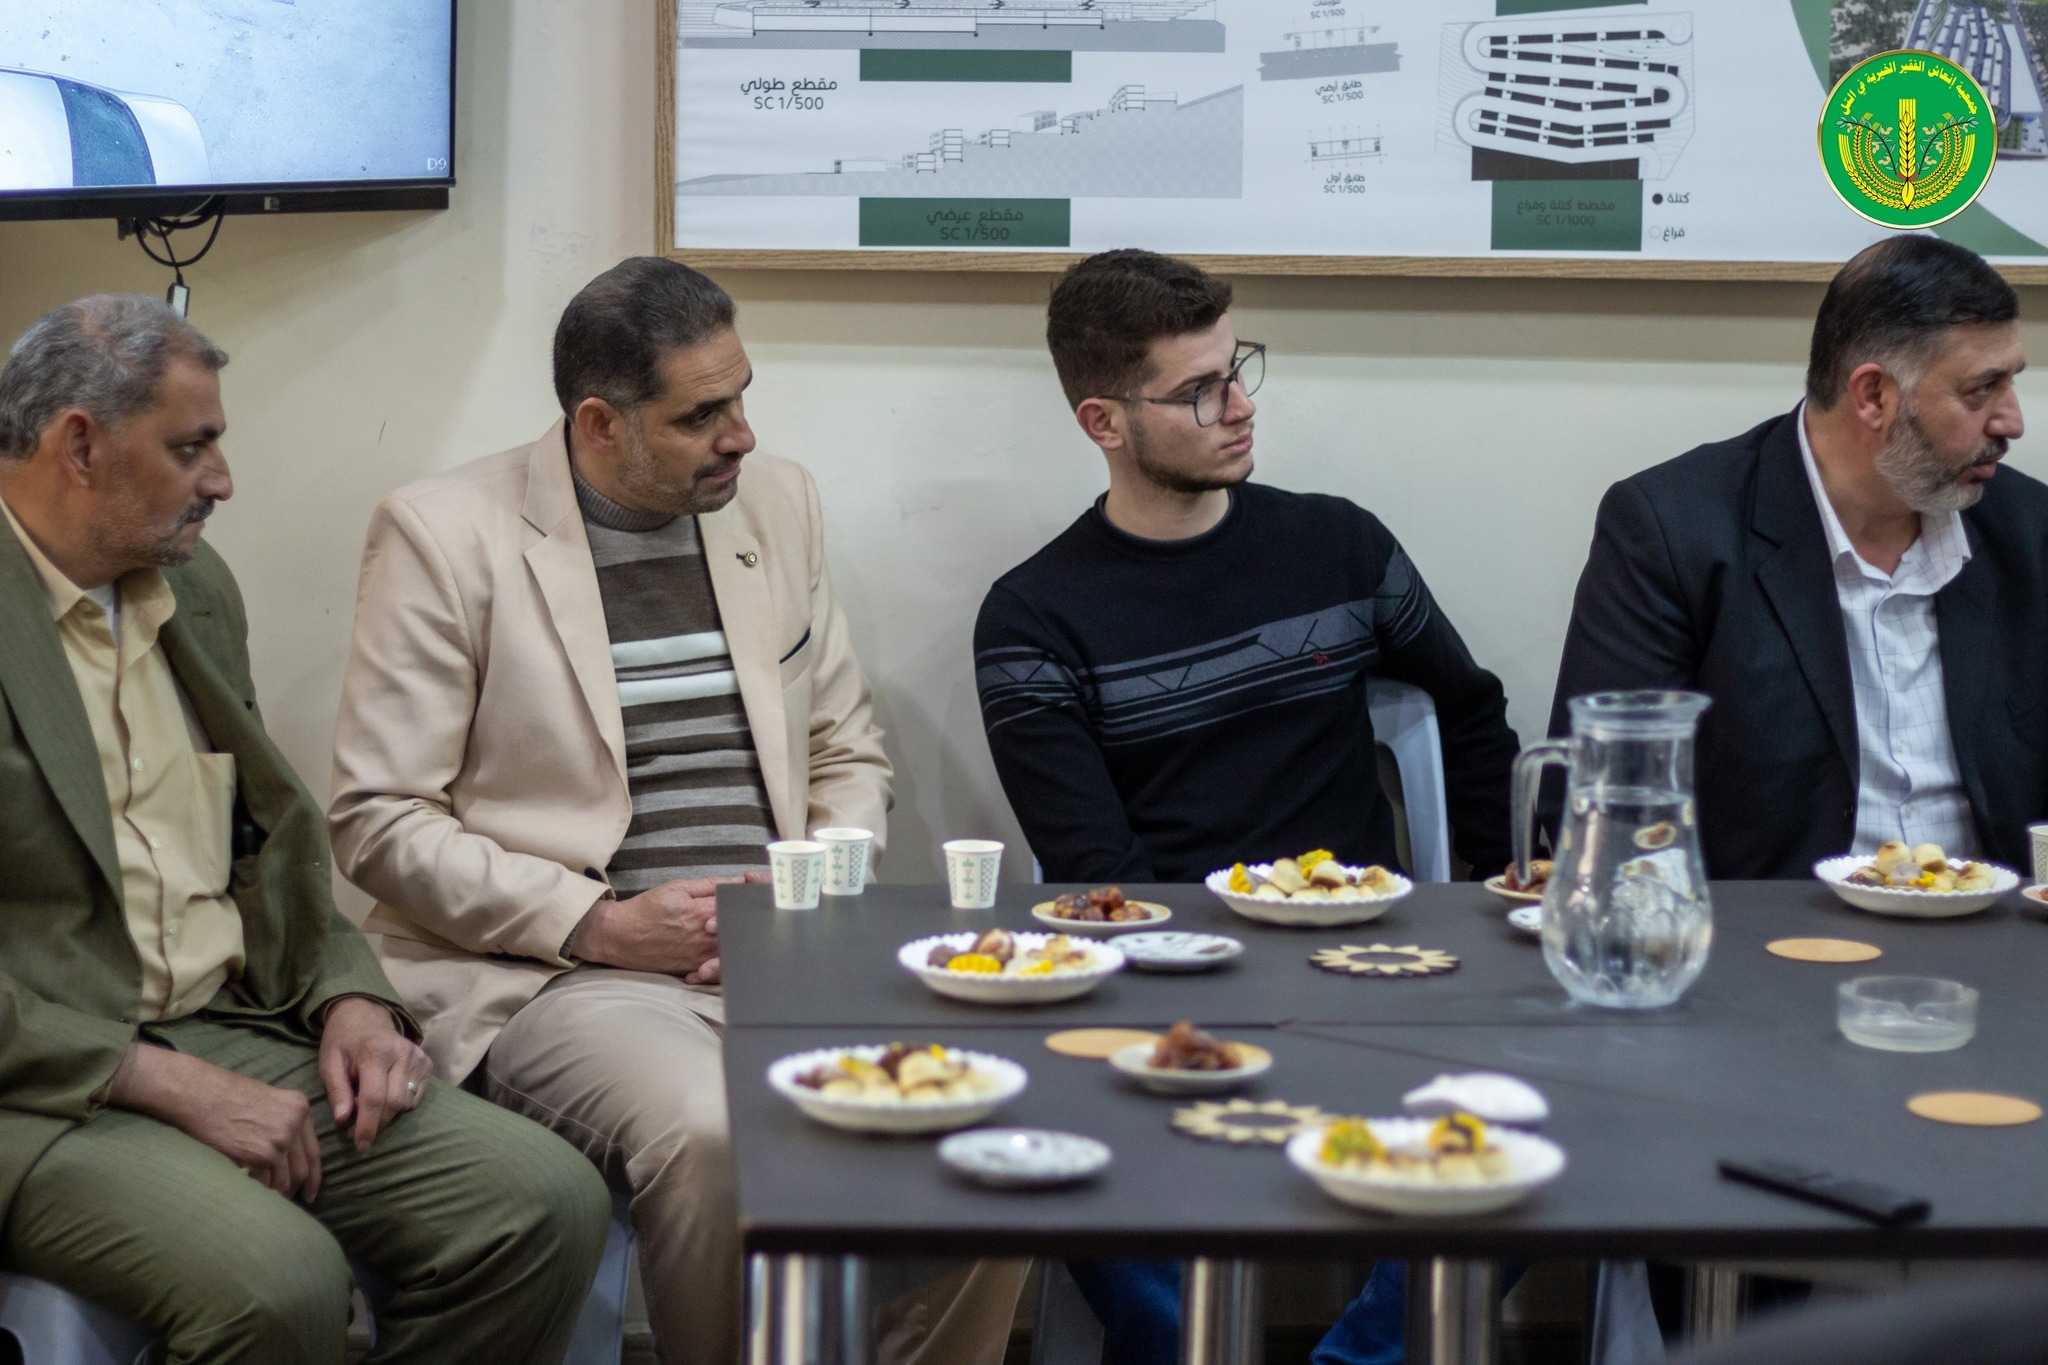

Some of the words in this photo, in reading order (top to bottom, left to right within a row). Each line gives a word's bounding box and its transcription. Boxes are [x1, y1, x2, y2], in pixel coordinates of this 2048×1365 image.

[740, 77, 785, 95] طولي
[791, 77, 838, 97] مقطع
[753, 96, 774, 110] SC
[778, 96, 824, 110] 1/500
[1322, 94, 1335, 104] SC
[1336, 90, 1364, 102] 1/500
[427, 157, 447, 171] D9
[1323, 184, 1336, 194] SC
[1338, 184, 1366, 194] 1/500
[926, 208, 972, 226] عرضي
[978, 208, 1024, 228] مقطع
[1536, 213, 1552, 226] SC
[1554, 213, 1596, 226] 1/1000
[940, 226, 961, 241] SC
[963, 226, 1010, 241] 1/500
